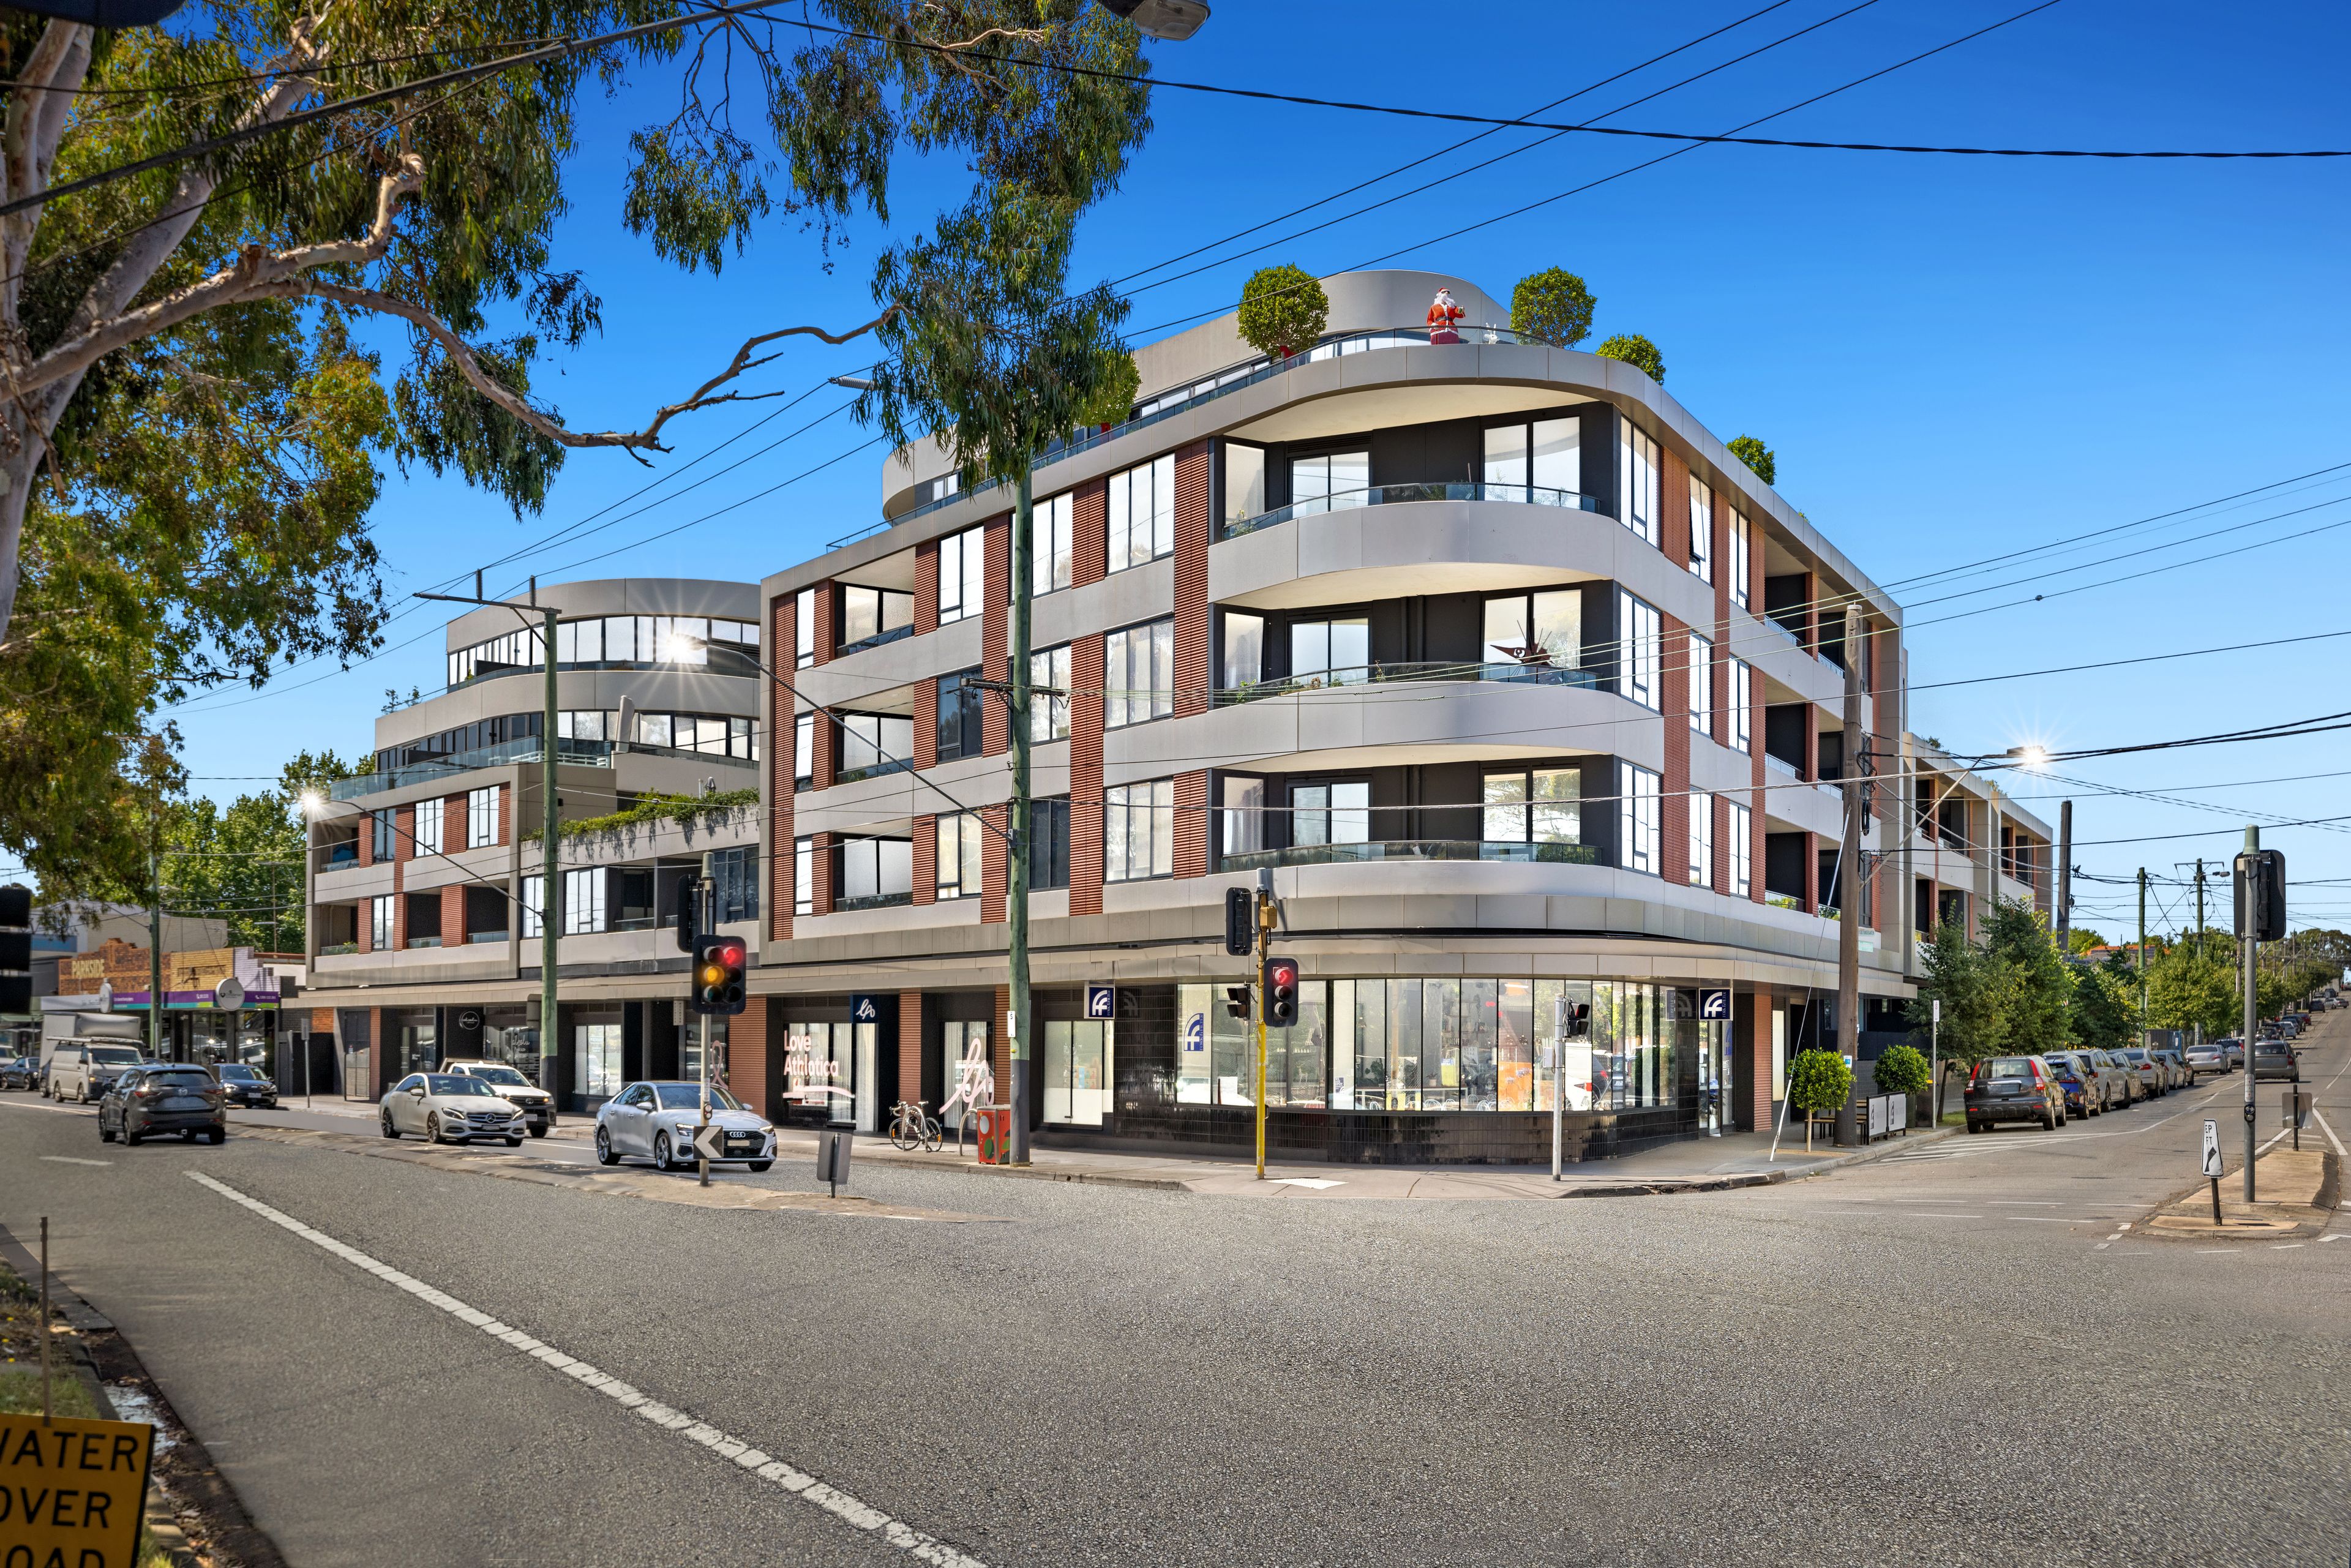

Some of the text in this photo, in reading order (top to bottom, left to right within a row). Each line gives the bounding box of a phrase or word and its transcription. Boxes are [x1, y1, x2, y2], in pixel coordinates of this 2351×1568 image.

[72, 959, 105, 979] PARKSIDE
[784, 1030, 812, 1052] Love
[0, 1428, 138, 1472] ATER
[6, 1544, 105, 1568] OAD
